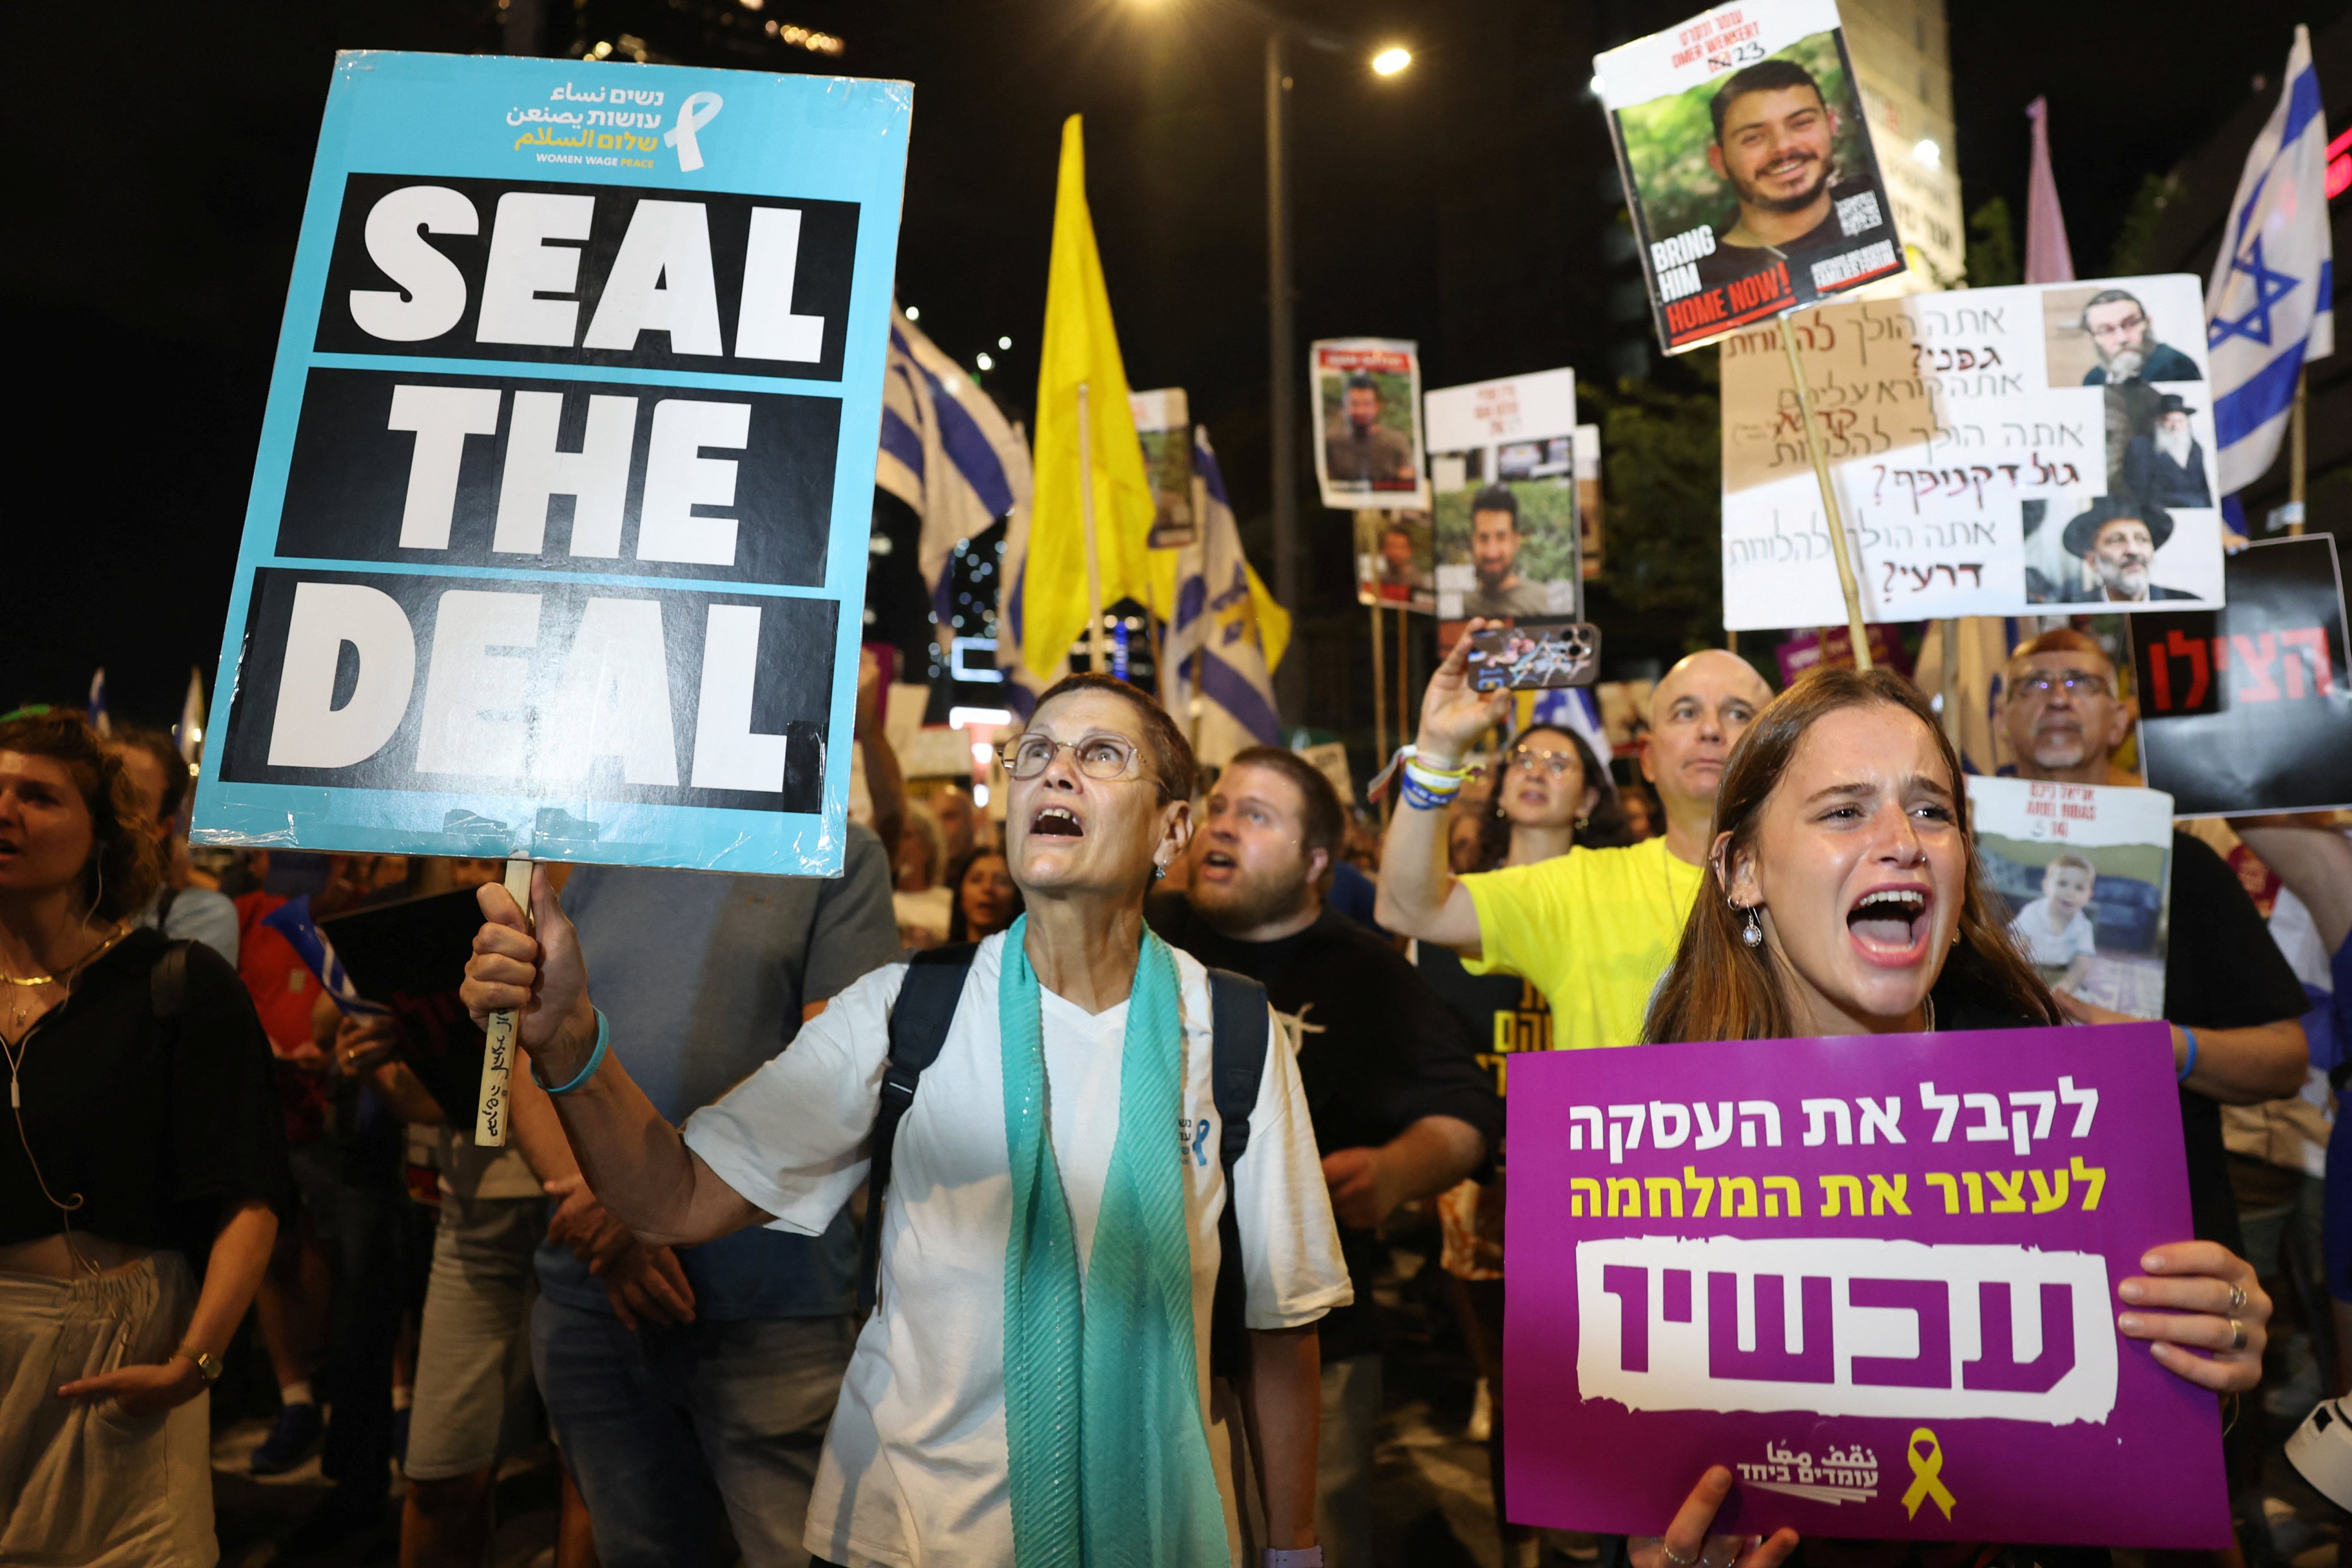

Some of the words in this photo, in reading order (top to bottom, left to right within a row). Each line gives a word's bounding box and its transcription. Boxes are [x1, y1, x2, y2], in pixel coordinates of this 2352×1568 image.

[1732, 41, 1766, 61] 23
[550, 82, 606, 103] نساء
[609, 88, 665, 107] נשים
[506, 107, 584, 130] يصنعن
[514, 127, 595, 151] السلام
[586, 110, 662, 129] עושות
[536, 153, 582, 164] WOMEN
[585, 156, 618, 167] WAGE
[620, 159, 654, 169] PEACE
[597, 131, 658, 152] שלום
[1650, 224, 1716, 273] BRING
[348, 185, 827, 364] SEAL
[1658, 261, 1702, 303] HIM
[1666, 287, 1729, 334] HOME
[1727, 260, 1793, 314] NOW!
[1846, 306, 1917, 366] הולך
[1925, 307, 2005, 335] אתה
[1911, 343, 2001, 376] גפני?
[1876, 376, 1944, 412] קורא
[1949, 373, 2023, 399] אתה
[1911, 412, 1984, 464] הולך
[2001, 423, 2084, 447] אתה
[388, 384, 751, 566] THE
[1846, 508, 1913, 573] הולך
[1925, 521, 1996, 548] אתה
[1883, 562, 1983, 603] דרעי?
[267, 581, 787, 793] DEAL
[2149, 627, 2334, 712] הצילו
[1569, 1099, 1782, 1164] העסקה
[1801, 1095, 1906, 1147] את
[1919, 1075, 2100, 1156] לקבל
[1570, 1165, 1801, 1218] המלחמה
[1819, 1172, 1913, 1217] את
[1926, 1157, 2106, 1214] לעצור
[1603, 1264, 2077, 1395] עכשיו
[1737, 1463, 1791, 1482] ביחד
[1821, 1443, 1878, 1469] نقف
[1798, 1467, 1878, 1488] עומדים
